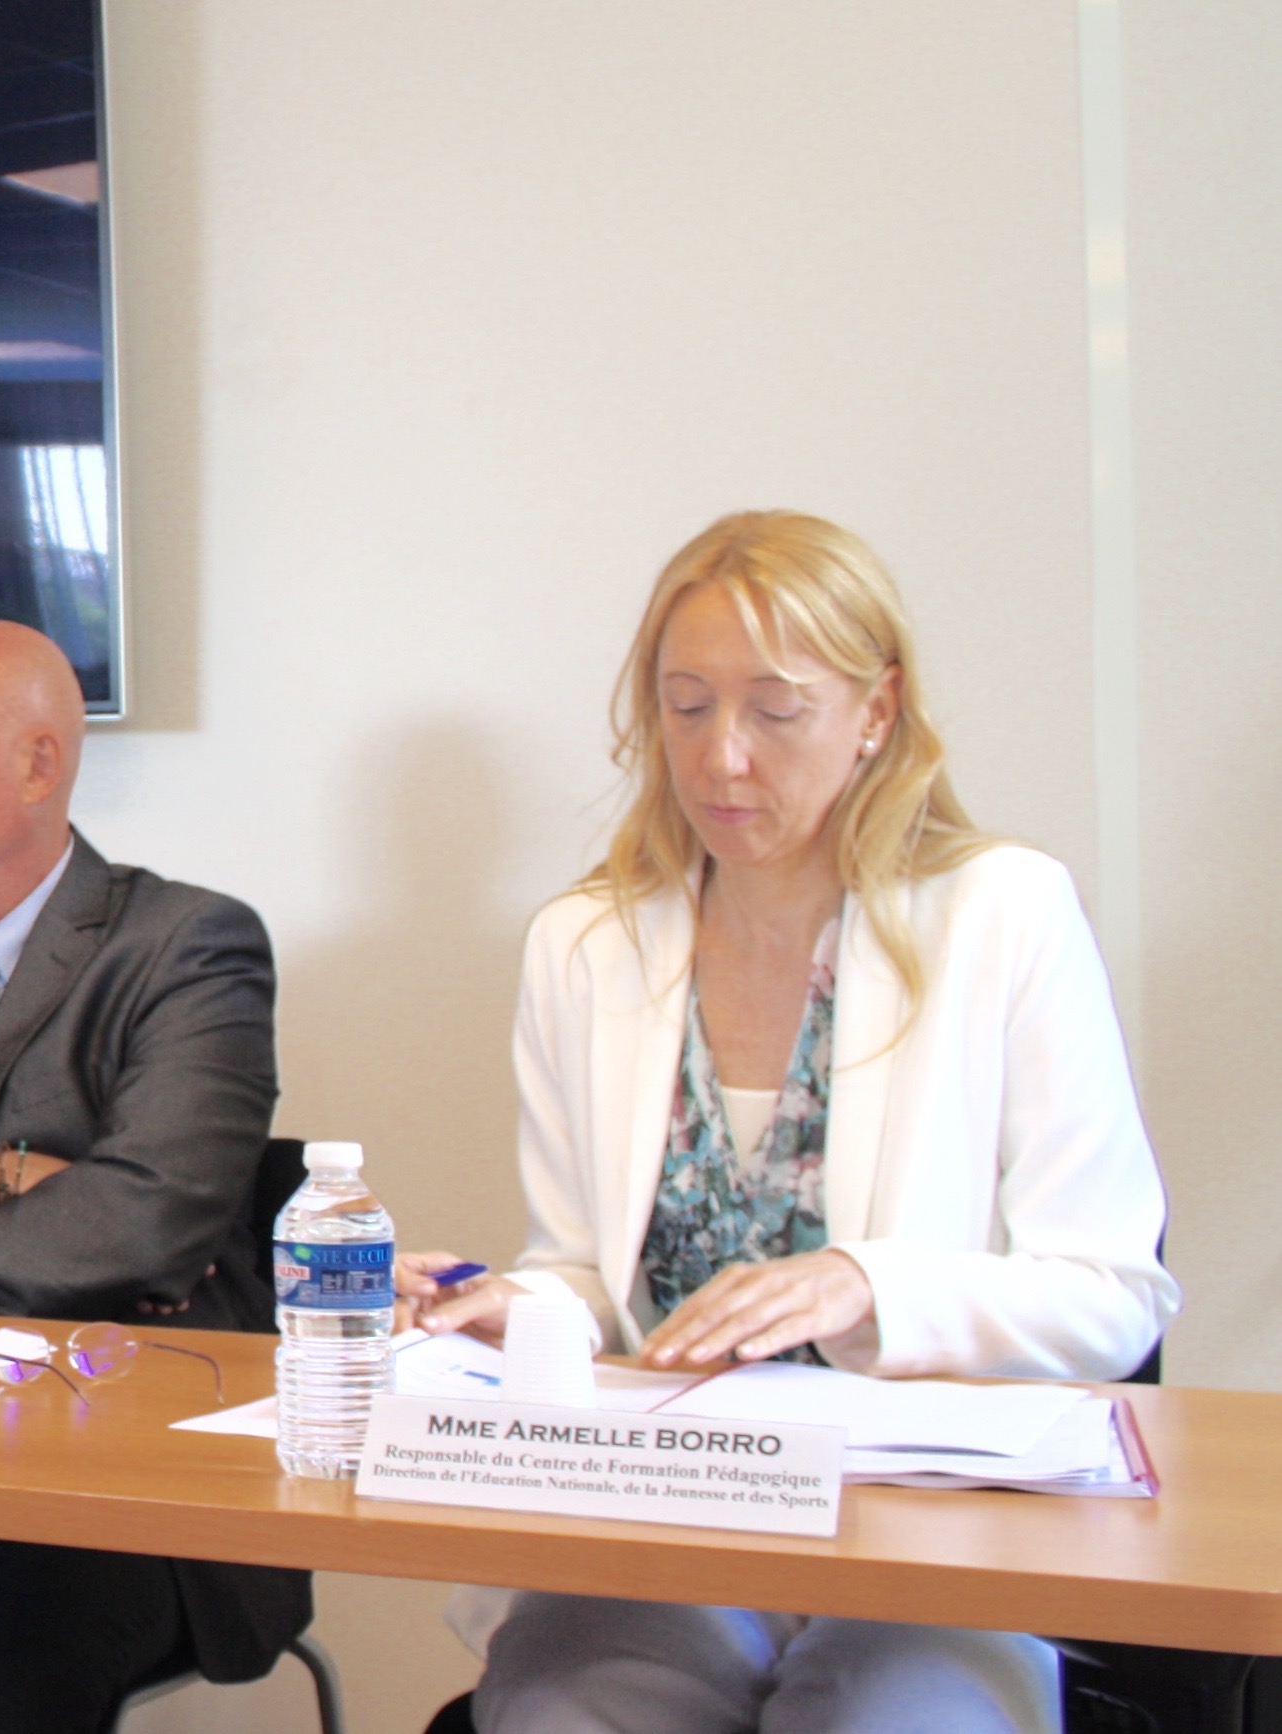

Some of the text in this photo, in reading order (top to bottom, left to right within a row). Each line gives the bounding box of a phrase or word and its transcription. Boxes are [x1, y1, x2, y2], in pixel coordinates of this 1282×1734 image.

[504, 1419, 647, 1449] ARMELLE
[655, 1428, 782, 1457] BORRO
[373, 1464, 437, 1482] Direction
[440, 1468, 458, 1483] de
[547, 1476, 621, 1496] Nationale,
[624, 1481, 643, 1496] de
[645, 1482, 659, 1497] la
[662, 1484, 729, 1502] Jeunesse
[732, 1488, 747, 1502] et
[749, 1488, 776, 1505] des
[778, 1493, 831, 1511] Sports
[385, 1444, 824, 1490] Responsable du Centre de Formation Pédagogique
